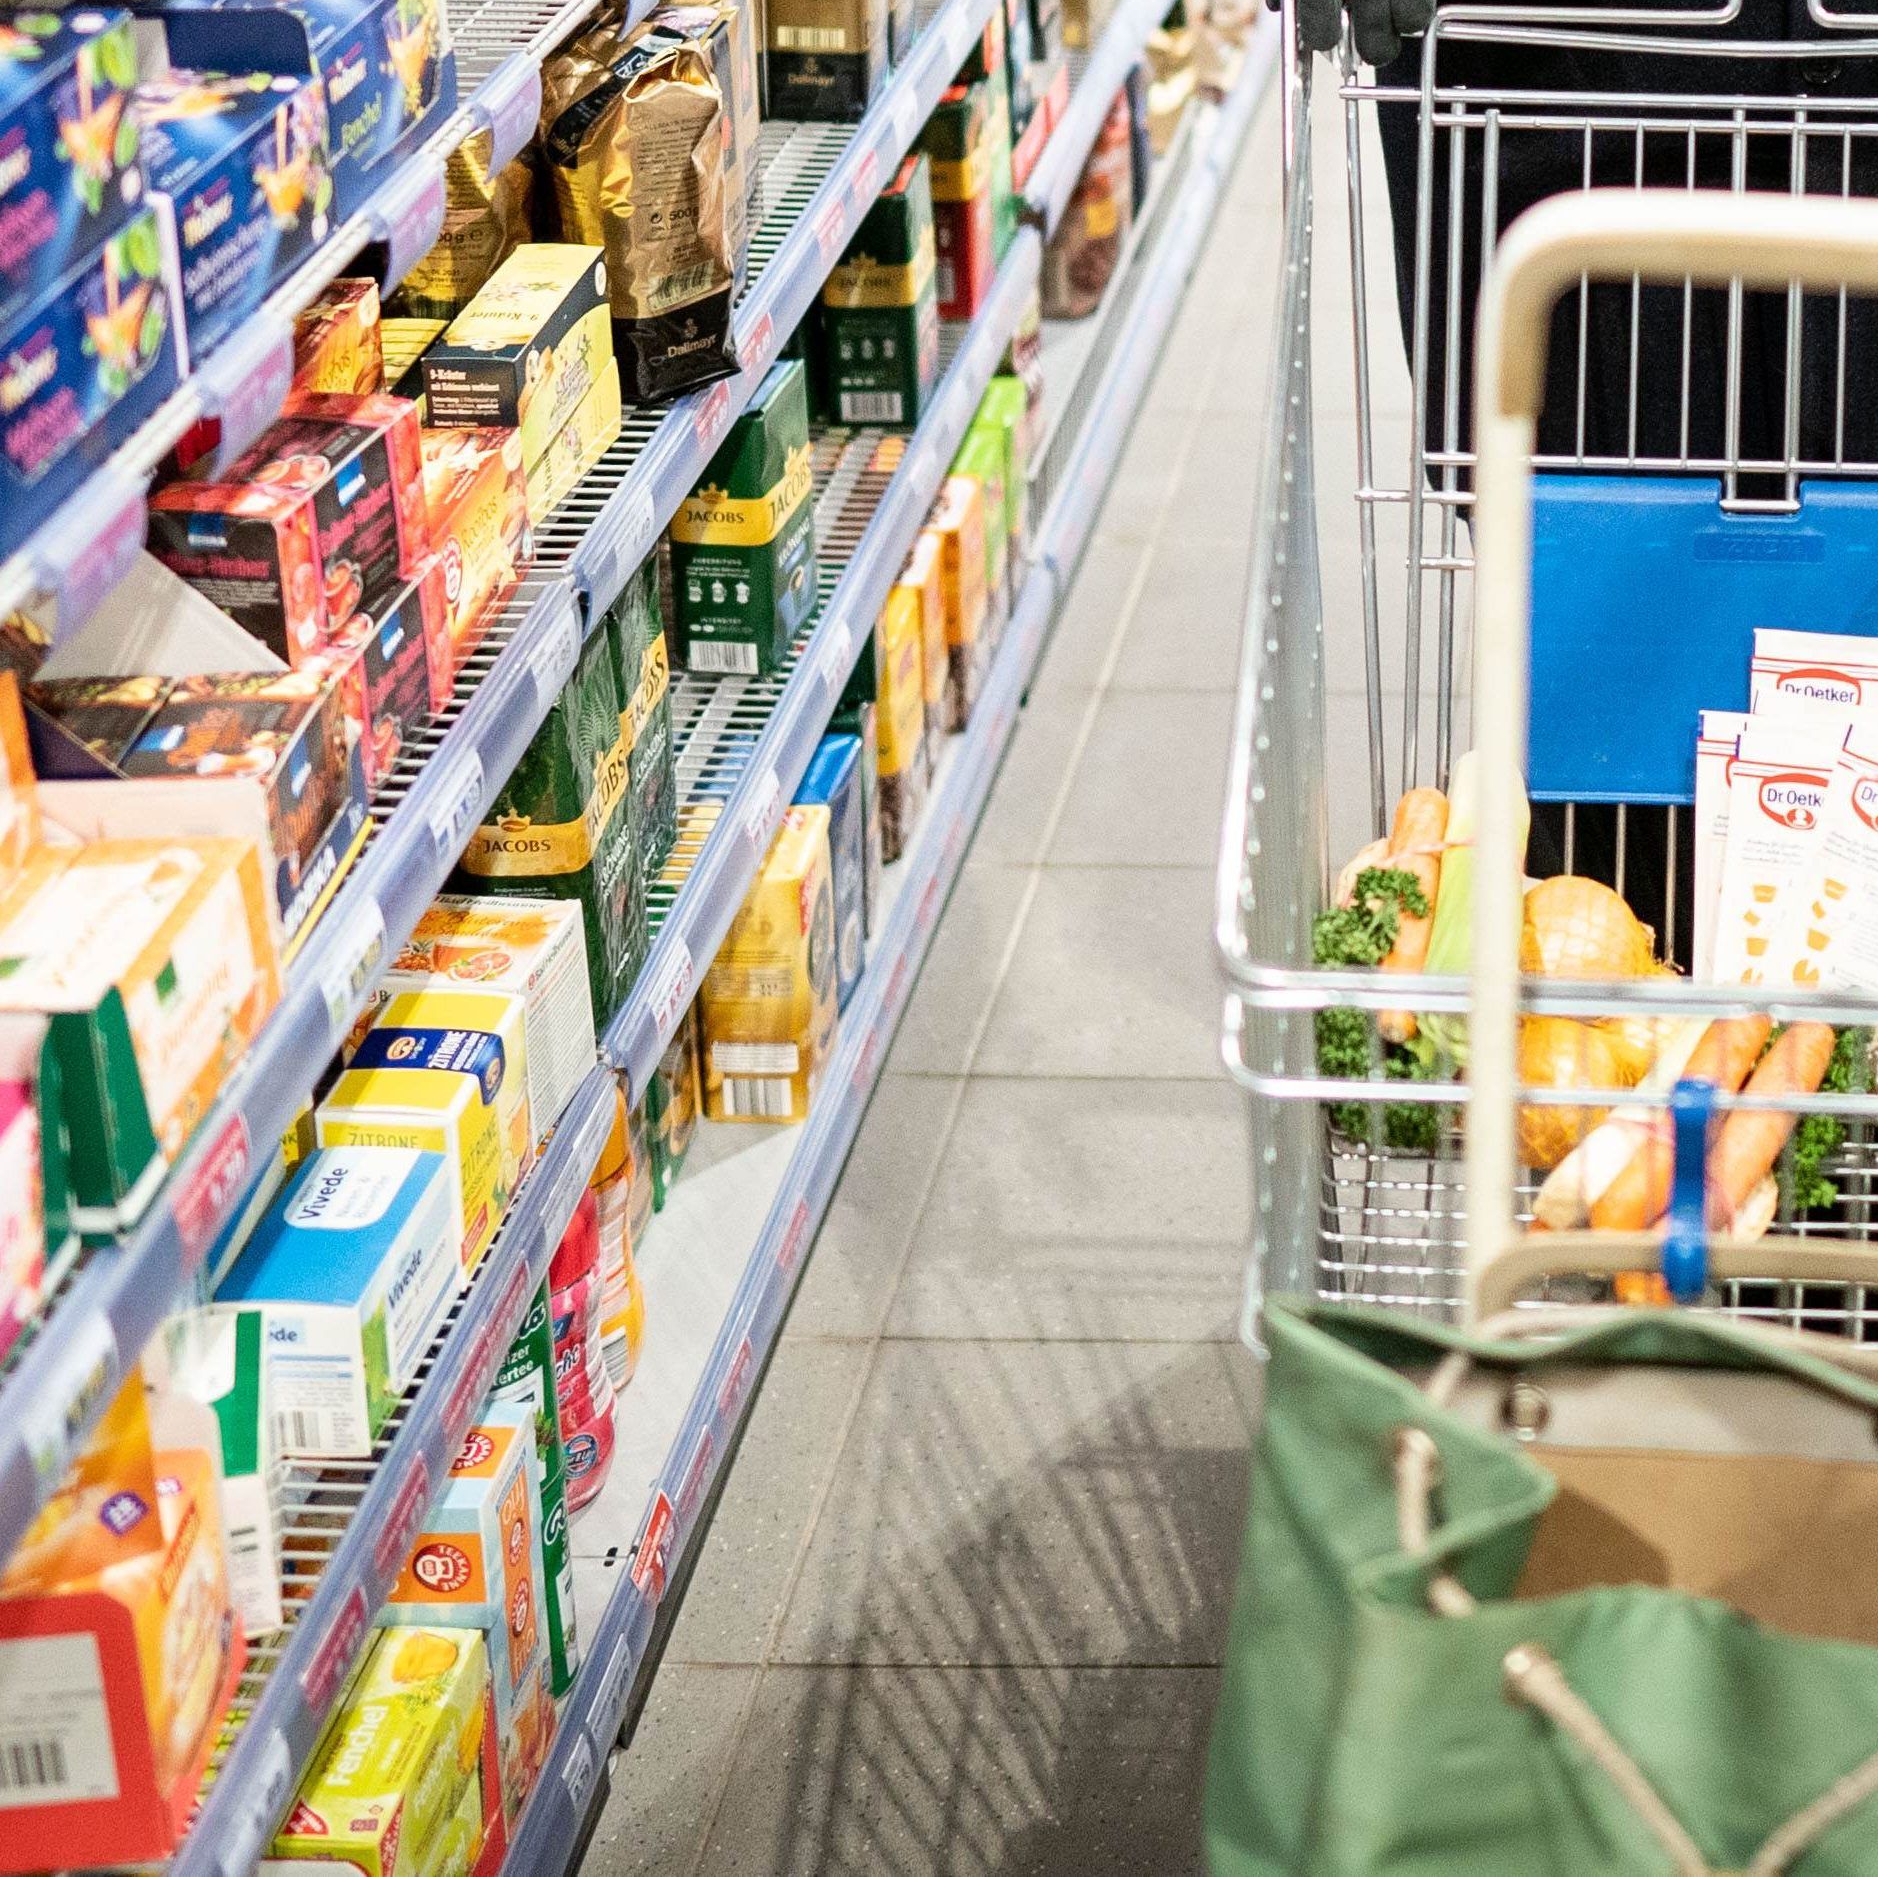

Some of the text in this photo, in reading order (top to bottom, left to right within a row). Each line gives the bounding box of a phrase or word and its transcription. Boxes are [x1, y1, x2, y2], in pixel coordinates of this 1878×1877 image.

[668, 335, 717, 358] Dallmayr
[686, 511, 745, 524] JACOBS
[1786, 788, 1822, 807] Oetk
[483, 839, 551, 854] JACOBS
[428, 1030, 467, 1068] ZITRONE
[350, 1132, 418, 1147] ZITRONE
[298, 1167, 348, 1221] Vivede
[326, 1704, 389, 1788] Fenchel
